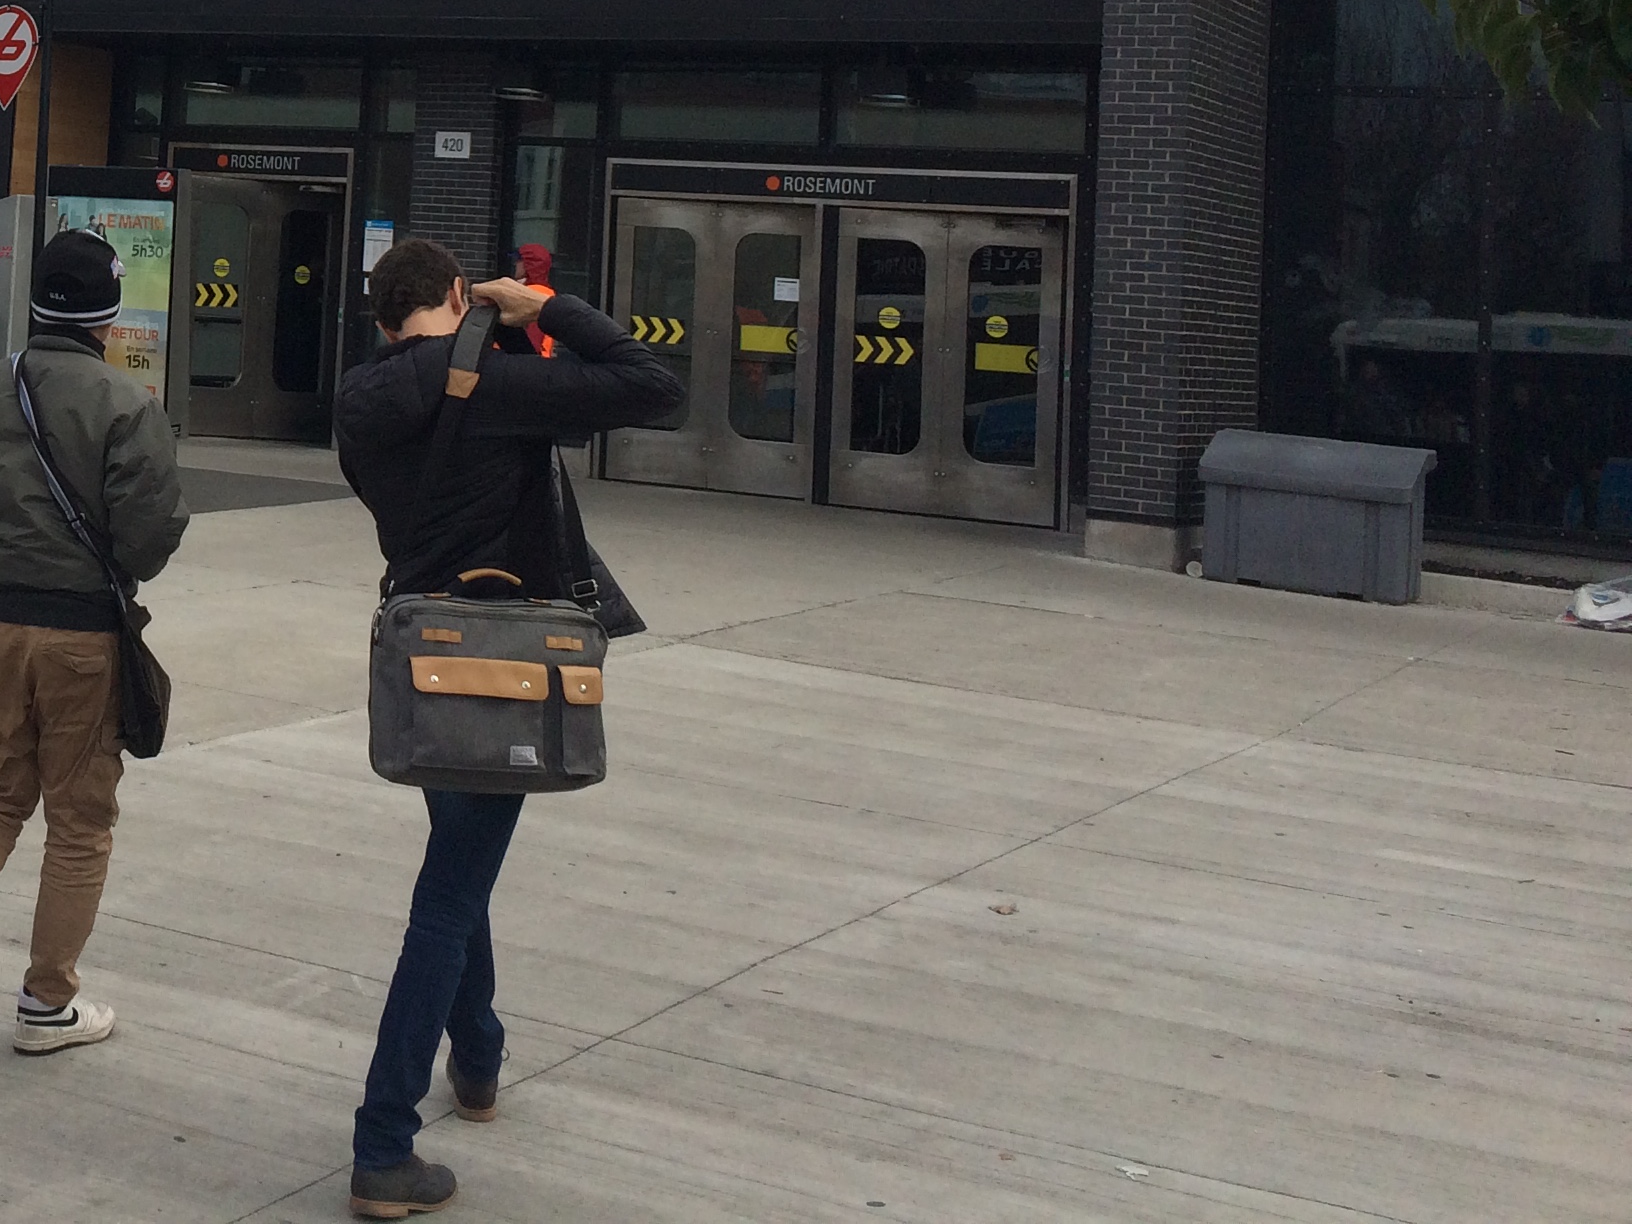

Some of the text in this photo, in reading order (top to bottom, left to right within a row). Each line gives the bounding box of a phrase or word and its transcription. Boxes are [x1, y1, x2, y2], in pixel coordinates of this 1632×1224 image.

[441, 137, 464, 152] 420
[230, 154, 301, 171] ROSEMONT
[783, 176, 876, 196] ROSEMONT
[118, 215, 165, 232] MATIN
[131, 244, 164, 259] 5h30
[111, 327, 159, 342] RETOUR
[125, 354, 150, 370] 15h
